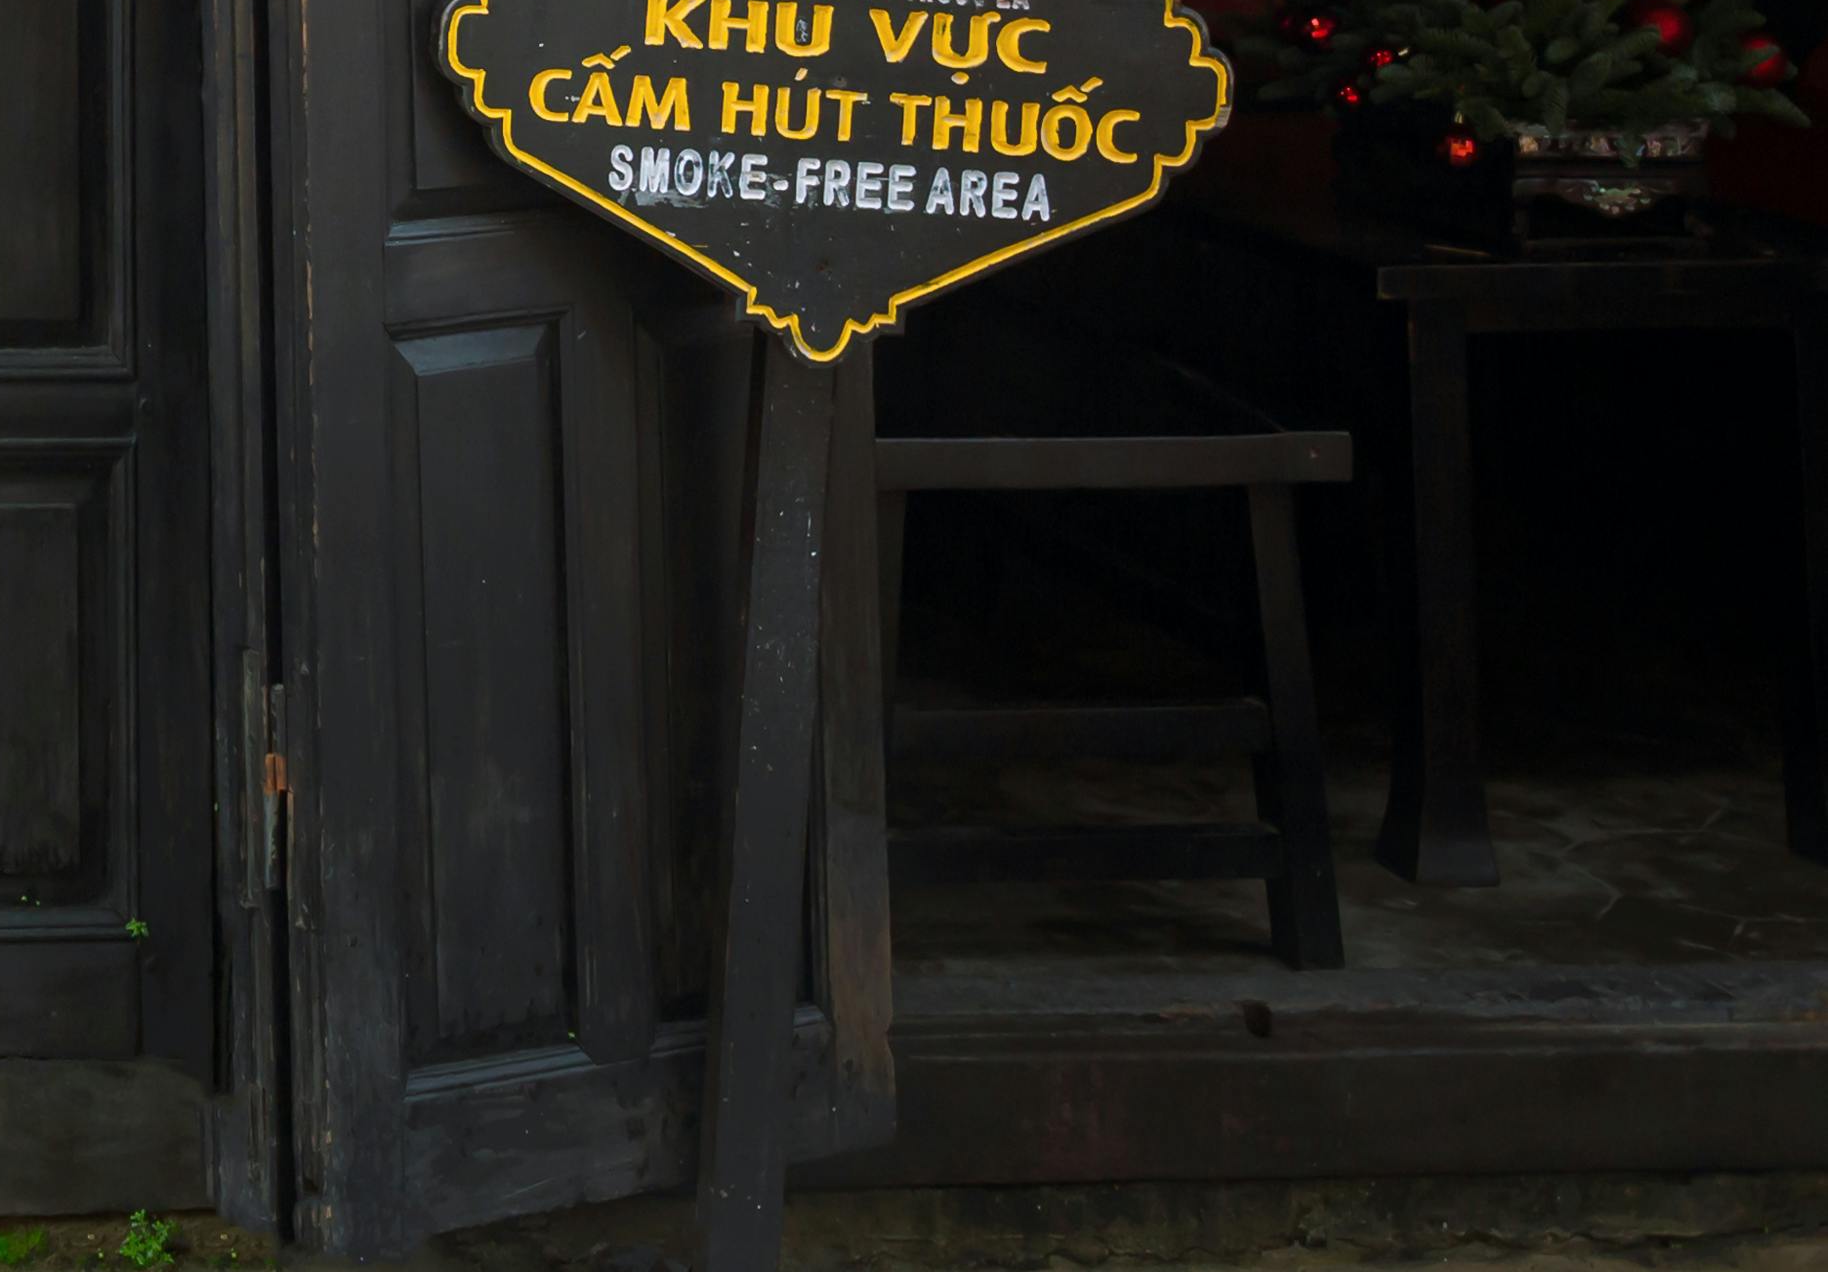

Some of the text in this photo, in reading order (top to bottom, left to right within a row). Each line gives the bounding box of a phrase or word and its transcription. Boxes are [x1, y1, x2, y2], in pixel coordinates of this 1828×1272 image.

[869, 10, 1051, 85] VỰC
[529, 44, 1141, 164] CẤM HÚT THUỐC
[608, 143, 1051, 223] SMOKE-FREE AREA
